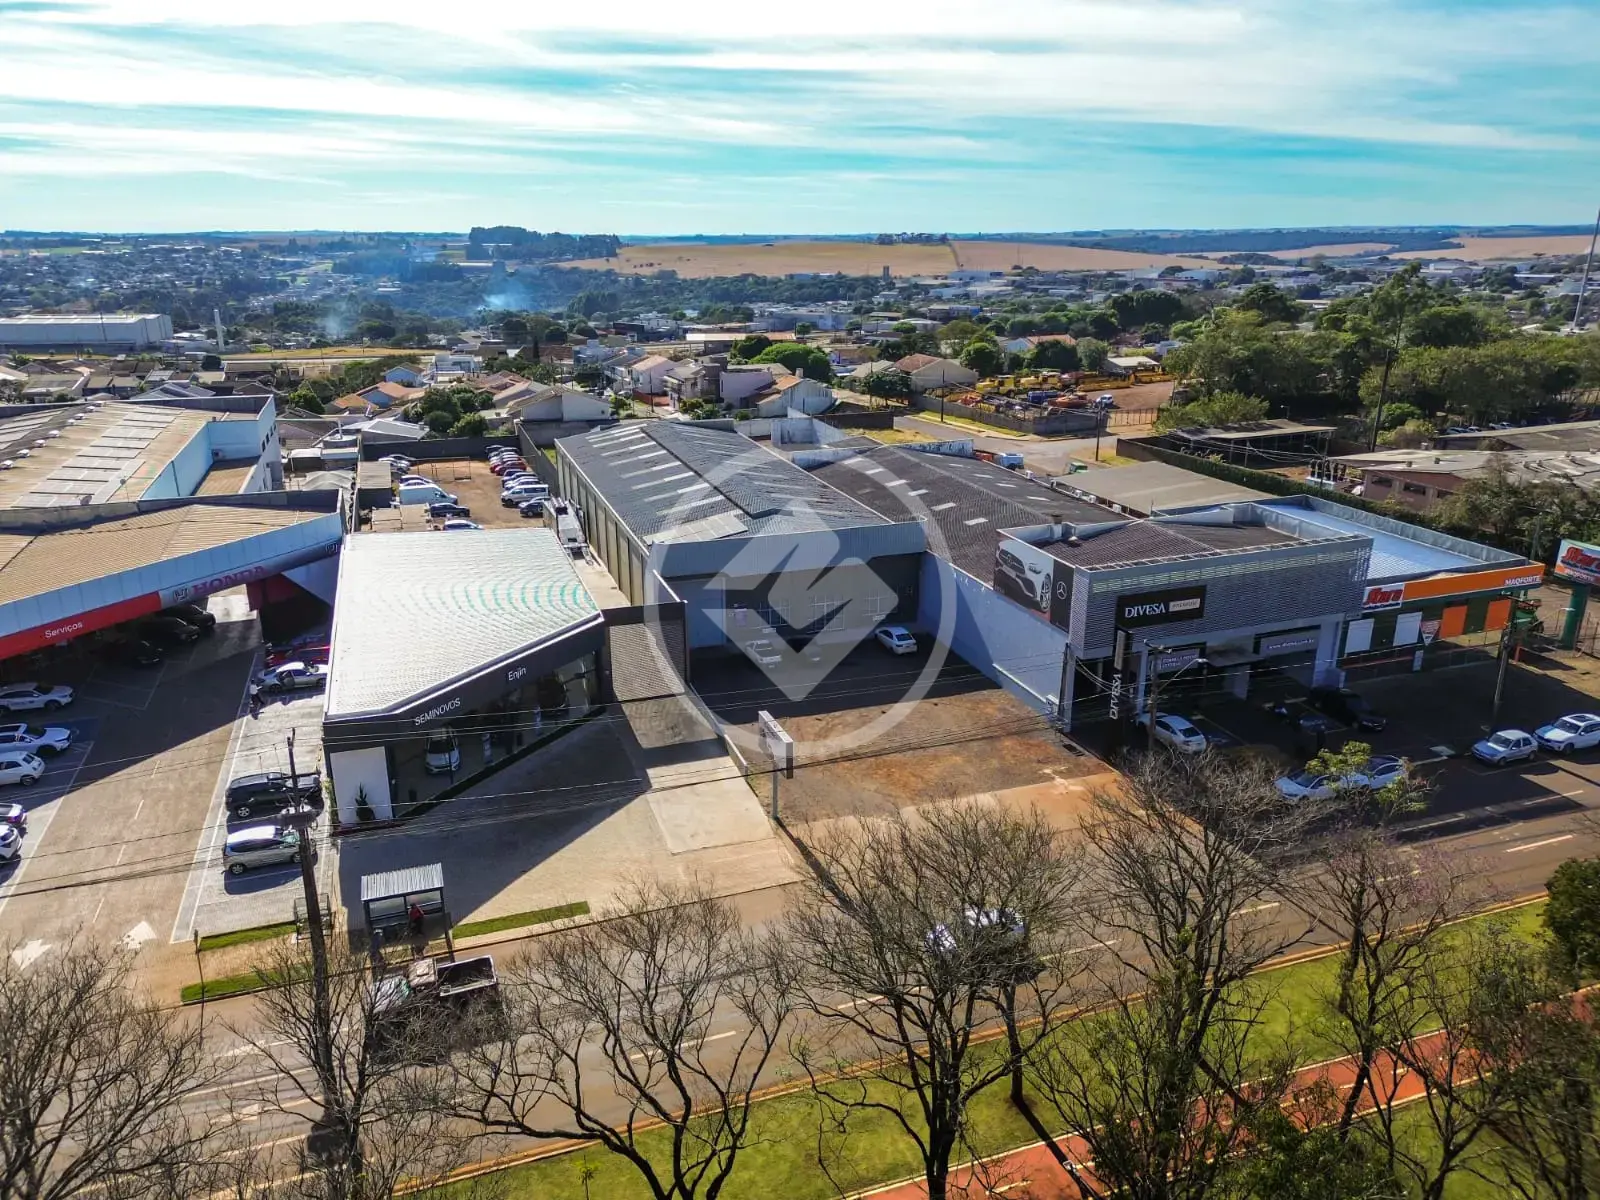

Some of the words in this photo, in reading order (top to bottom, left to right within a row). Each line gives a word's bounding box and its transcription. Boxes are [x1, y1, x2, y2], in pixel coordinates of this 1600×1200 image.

[191, 565, 266, 597] HONDA
[1504, 575, 1542, 586] MAQFORTE
[1124, 602, 1166, 618] DIVESA
[45, 621, 83, 638] Serviços
[508, 666, 526, 681] Enjin
[1109, 673, 1122, 719] DIVESA
[415, 697, 461, 726] SEMINOVOS
